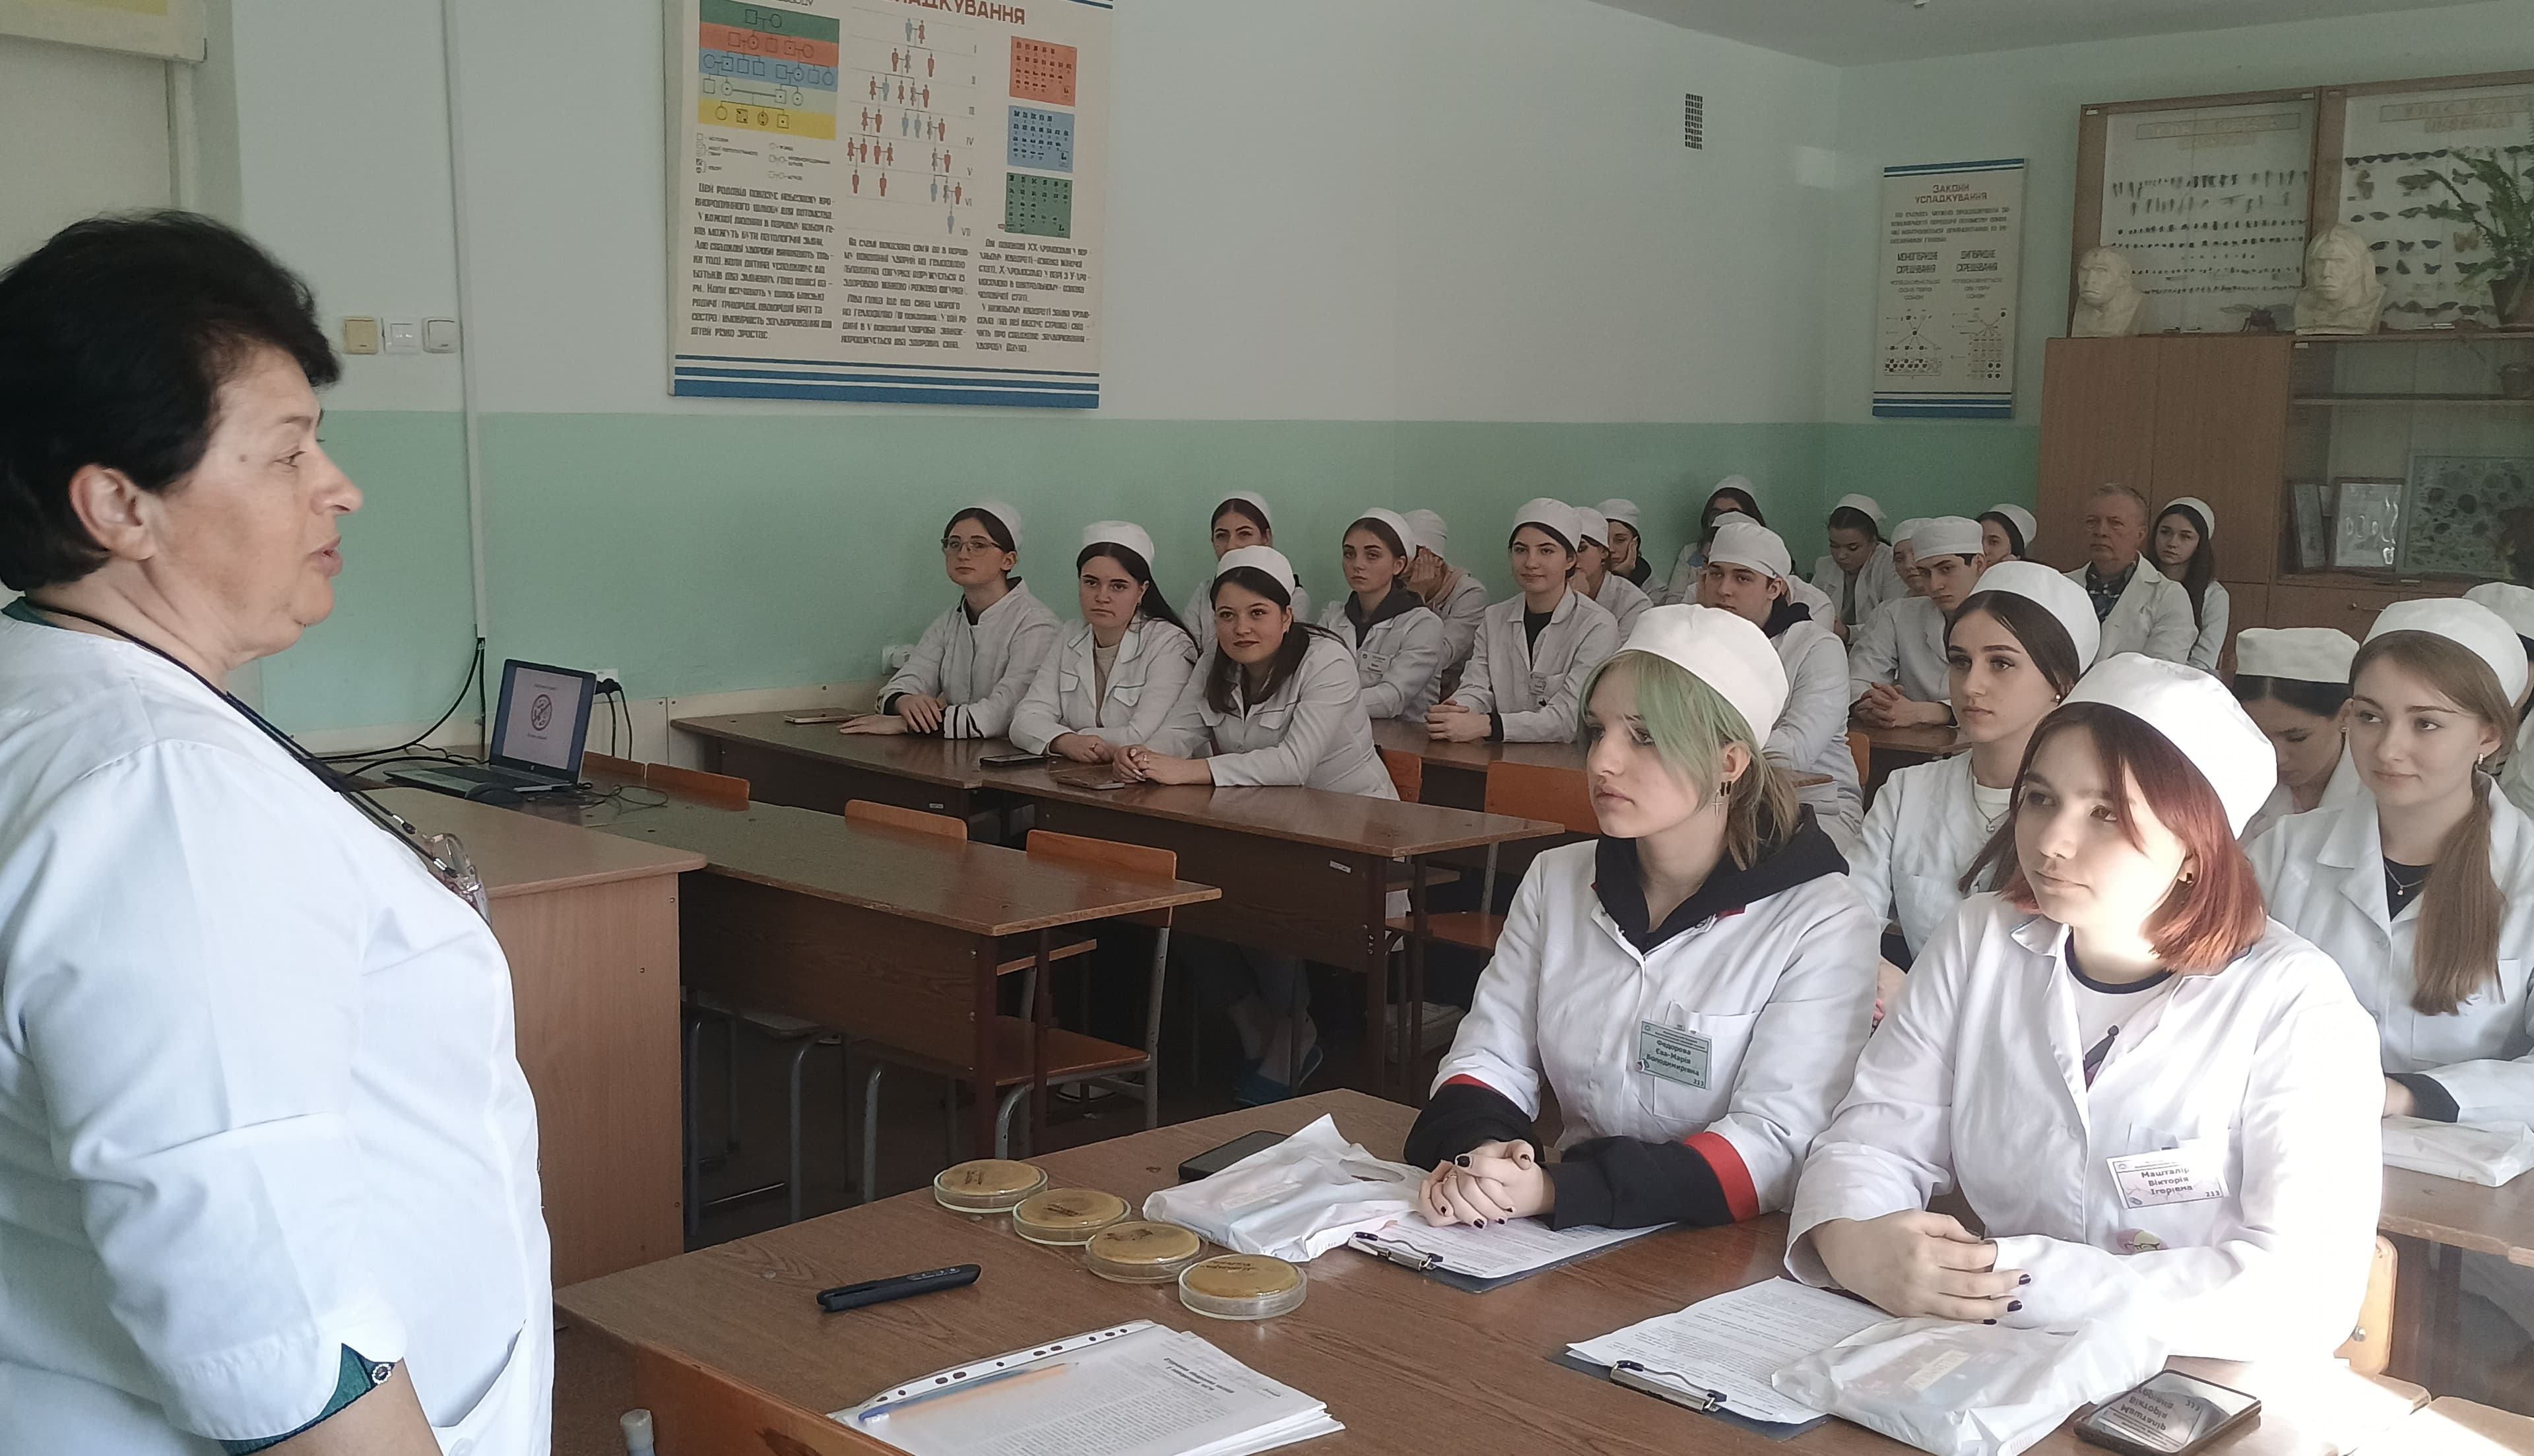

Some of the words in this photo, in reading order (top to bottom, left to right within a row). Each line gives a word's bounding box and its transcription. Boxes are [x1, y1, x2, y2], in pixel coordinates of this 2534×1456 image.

[887, 0, 1025, 24] ДКУВАННЯ
[1933, 185, 1969, 193] ЗАКОНИ
[1915, 193, 1987, 203] УСПАДКУВАННЯ
[1656, 1040, 1691, 1055] Федорова
[1646, 1054, 1699, 1076] Володимирівна
[2141, 1168, 2190, 1178] Машталір
[2149, 1177, 2189, 1186] Вікторія
[2151, 1185, 2193, 1195] Ігорівна
